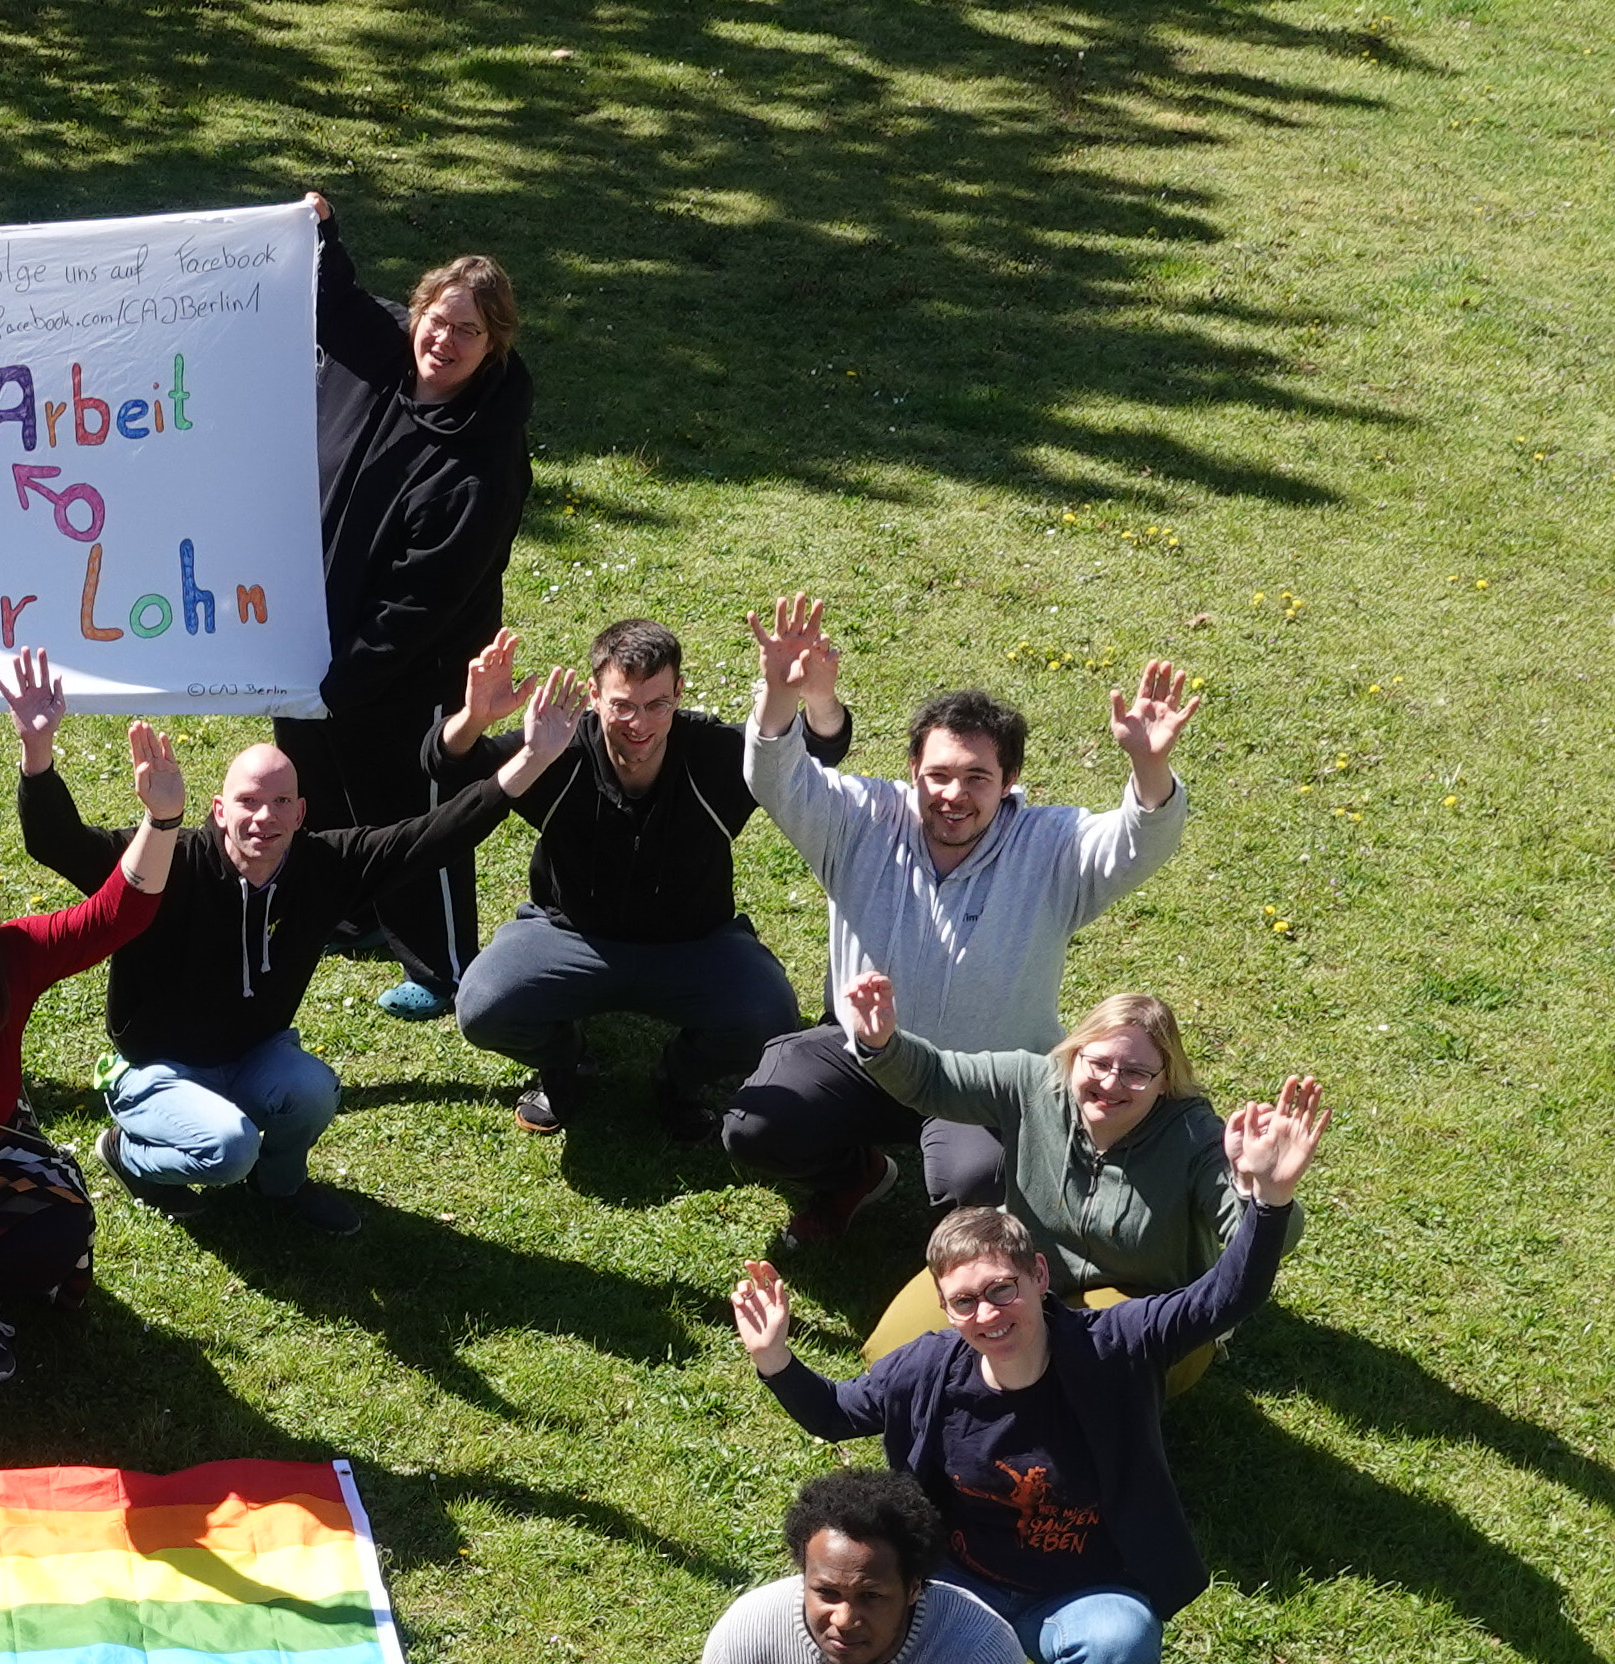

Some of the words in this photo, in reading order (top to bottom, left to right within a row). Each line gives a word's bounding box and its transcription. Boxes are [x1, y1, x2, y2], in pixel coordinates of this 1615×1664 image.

[65, 265, 97, 284] uns
[110, 243, 149, 285] auf
[174, 234, 277, 275] Facebook
[81, 537, 268, 642] Lohn
[209, 683, 238, 696] CAJ
[243, 683, 288, 696] Berlin
